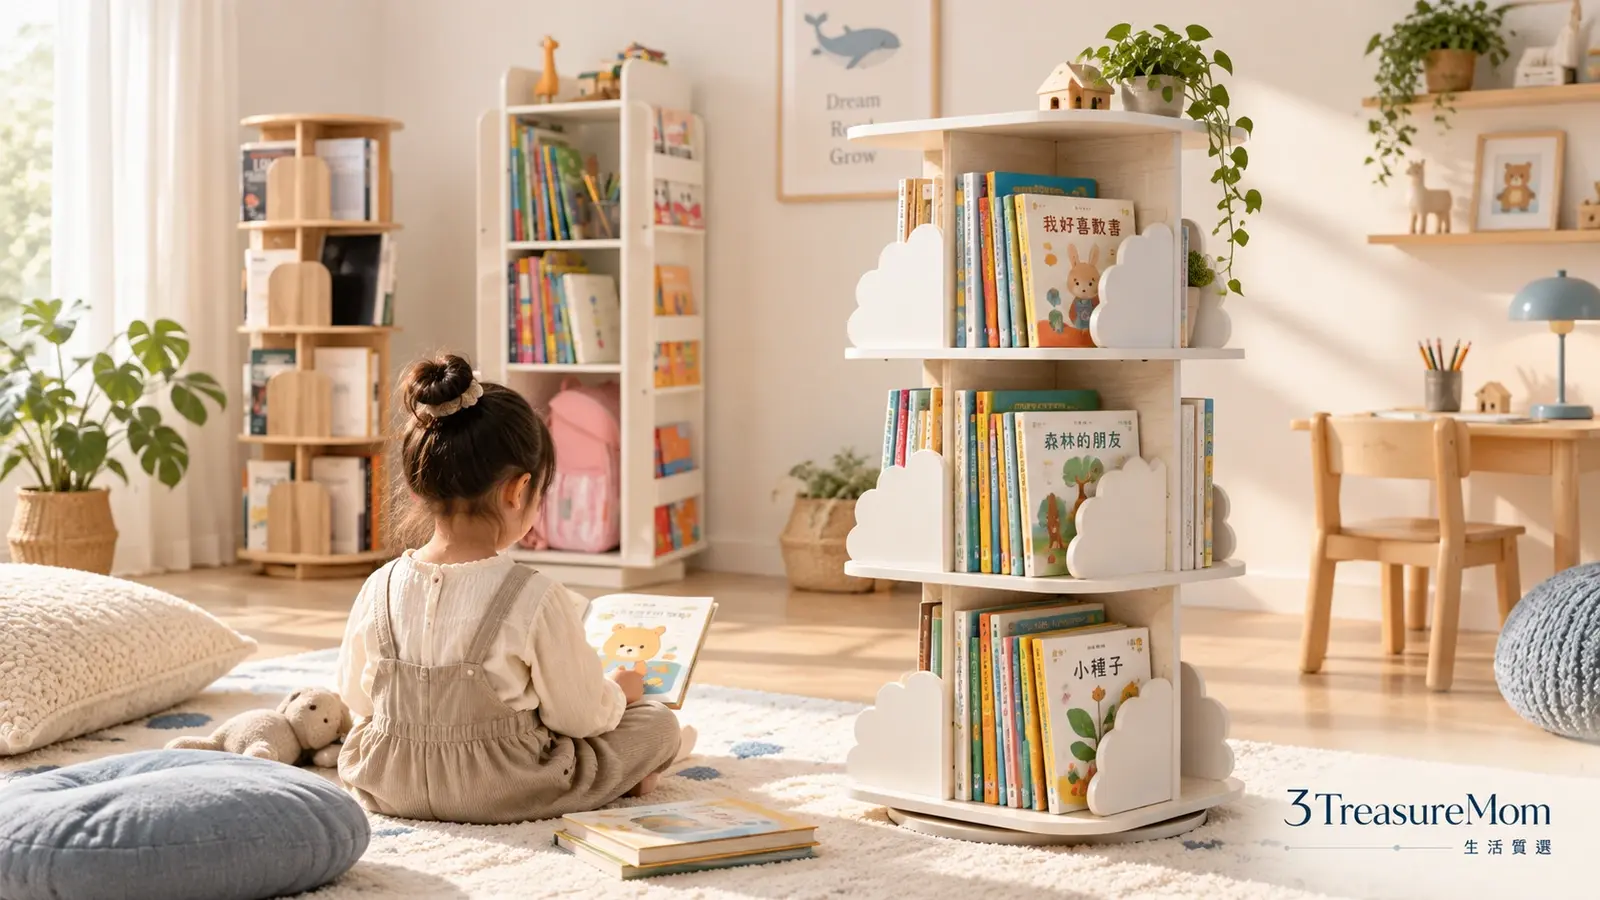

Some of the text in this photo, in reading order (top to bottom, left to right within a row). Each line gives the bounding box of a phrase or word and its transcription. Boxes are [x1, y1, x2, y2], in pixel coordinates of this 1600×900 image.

[826, 93, 881, 110] Dream
[829, 147, 877, 166] Grow
[1044, 431, 1122, 451] 森林的朋友
[1073, 655, 1124, 680] 小種子
